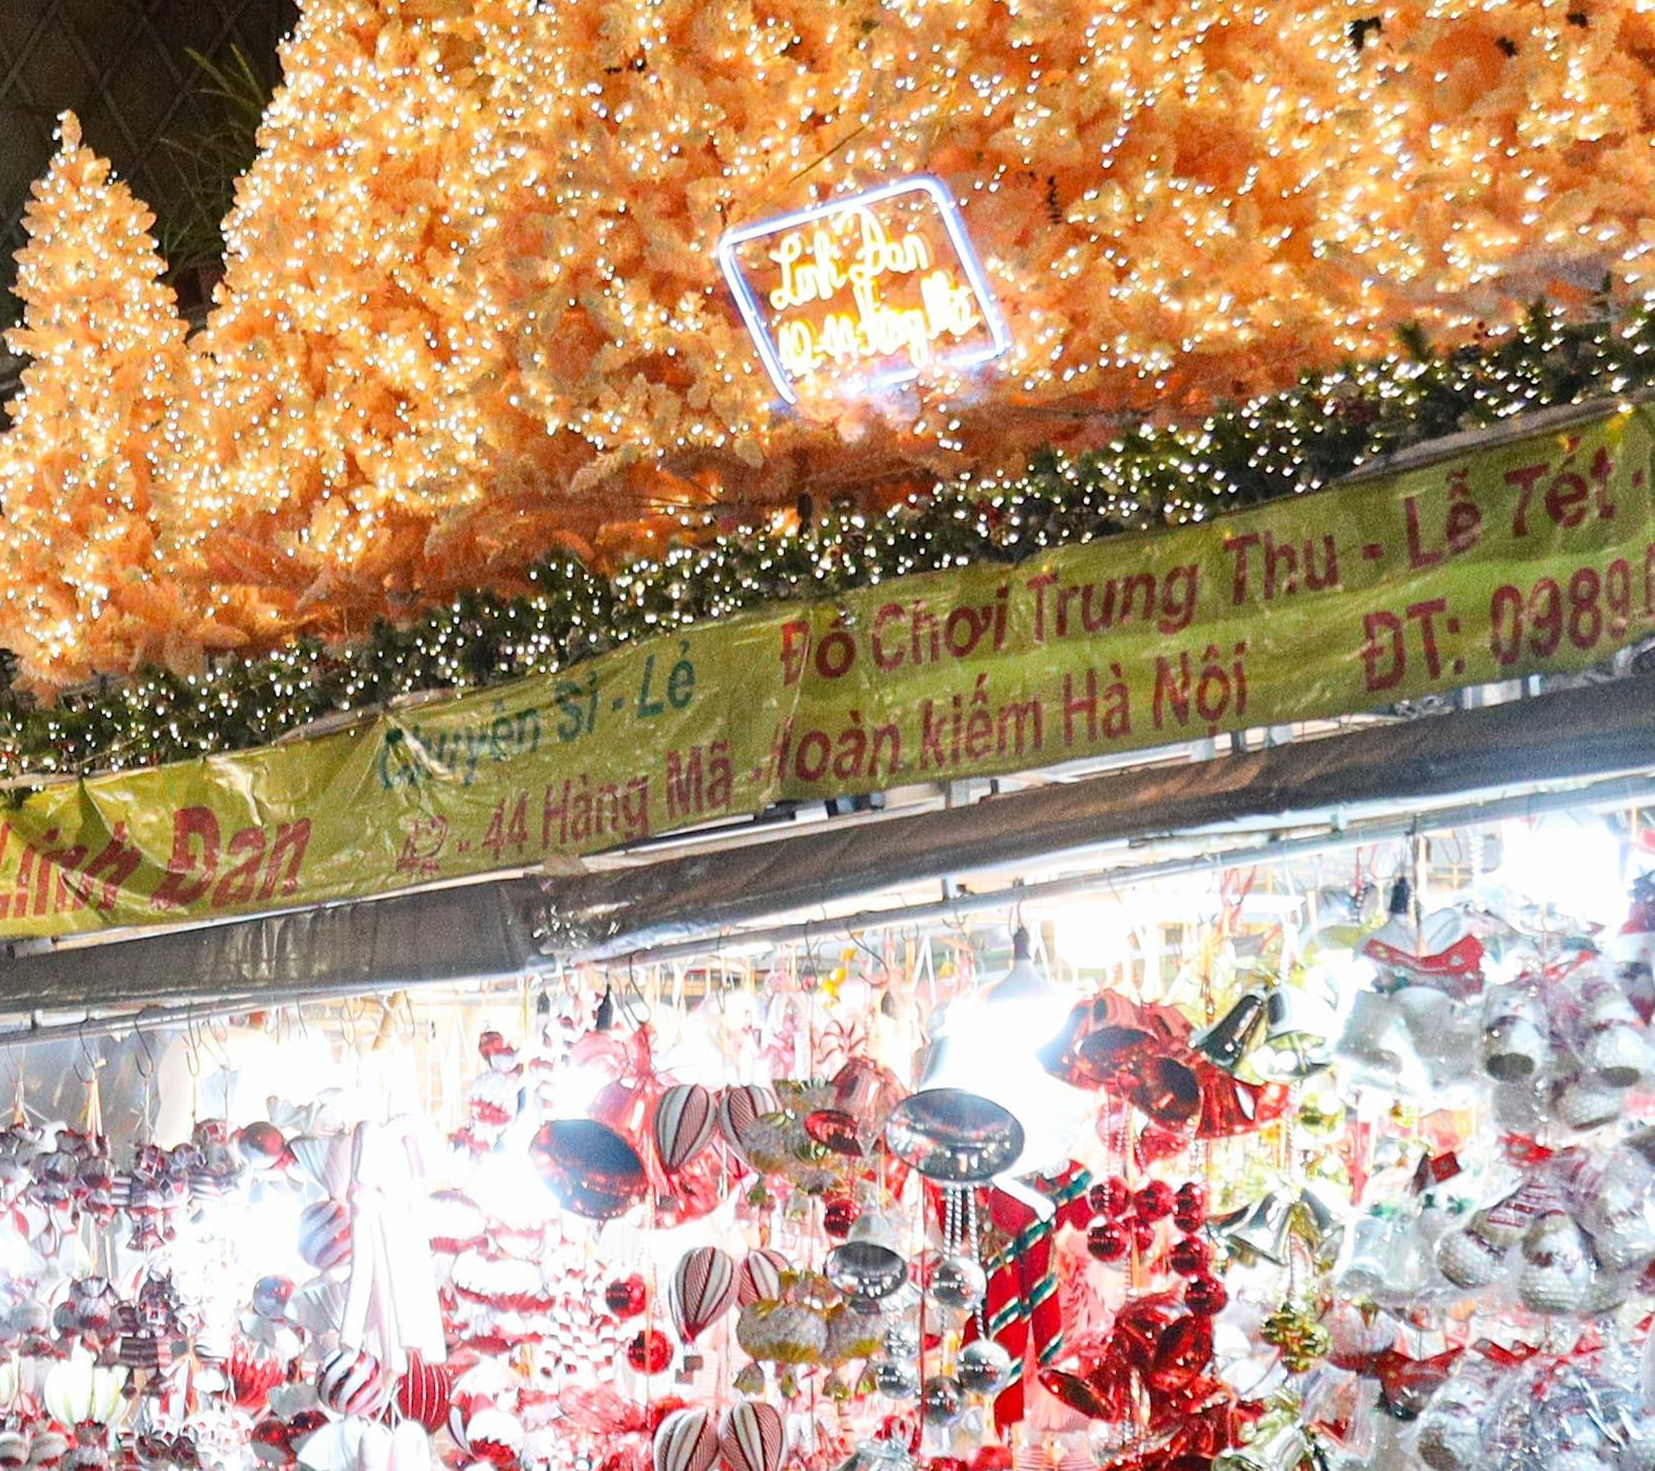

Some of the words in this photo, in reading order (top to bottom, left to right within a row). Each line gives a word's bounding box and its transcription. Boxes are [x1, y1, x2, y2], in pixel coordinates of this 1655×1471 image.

[872, 587, 1010, 671] Chơi
[1026, 562, 1199, 644] Trung
[1224, 530, 1339, 605] Thu
[1404, 467, 1482, 568] Lễ
[1360, 597, 1466, 693] ĐT:
[481, 791, 530, 862] 44
[542, 774, 650, 850] Hàng
[666, 738, 734, 822] Mã
[920, 670, 1044, 770] kiếm
[1062, 661, 1132, 748] Hà
[1151, 640, 1248, 738] Nội
